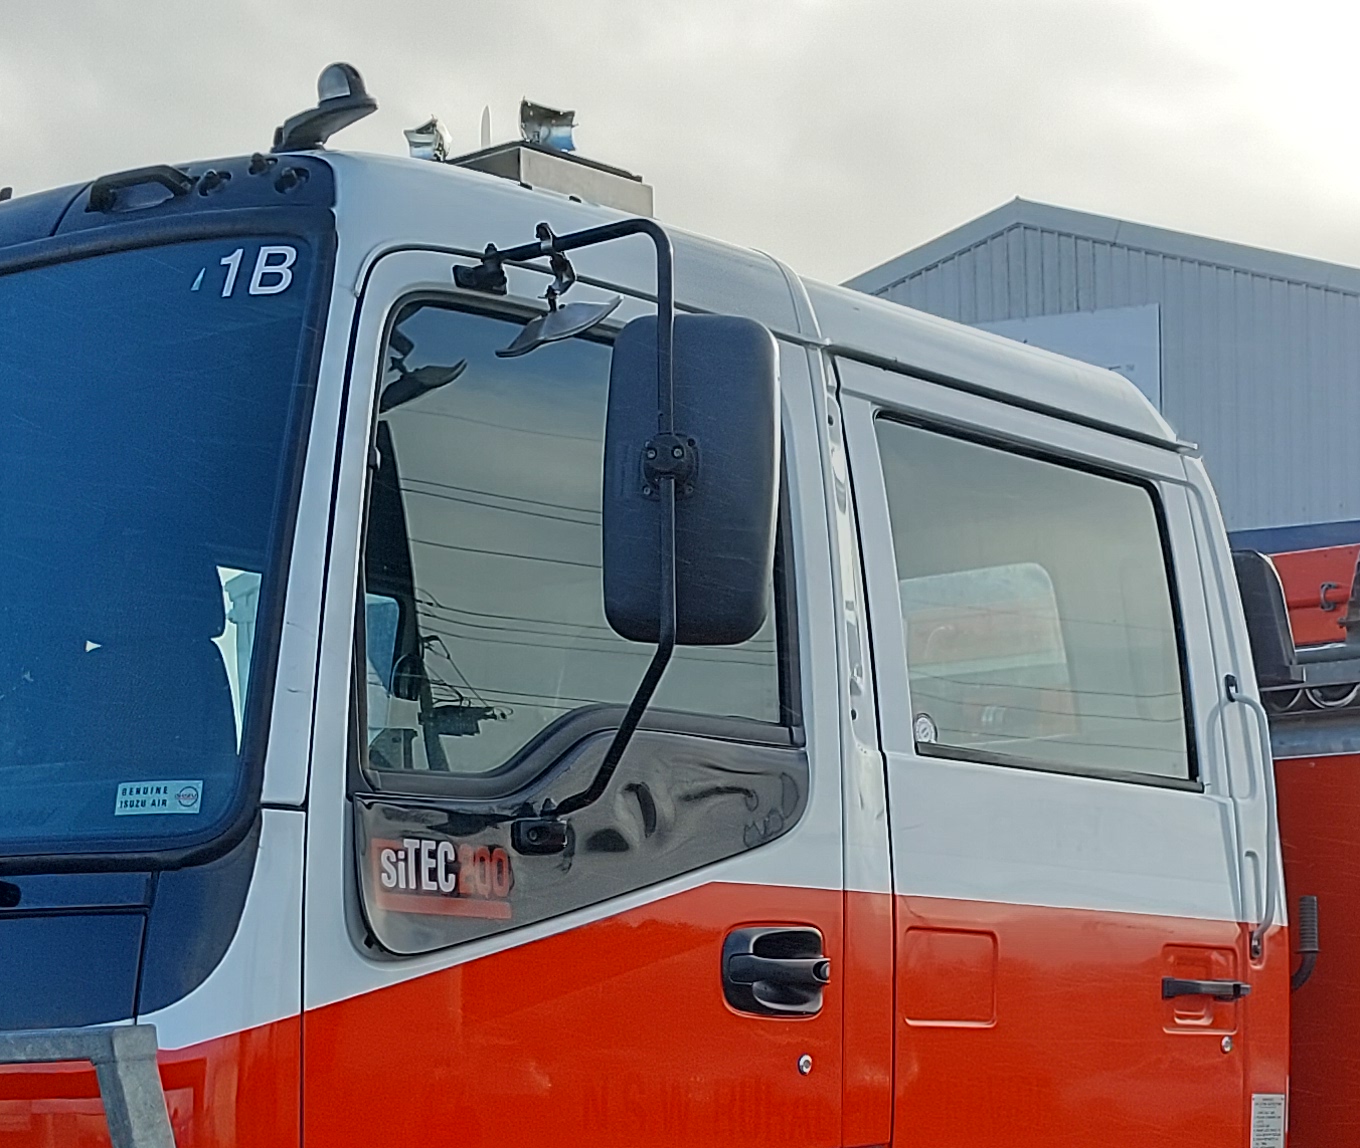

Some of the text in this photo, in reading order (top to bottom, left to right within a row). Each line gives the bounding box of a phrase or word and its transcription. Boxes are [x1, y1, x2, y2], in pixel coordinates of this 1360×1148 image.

[219, 245, 298, 297] 1B
[119, 798, 168, 809] ISUZU AIR
